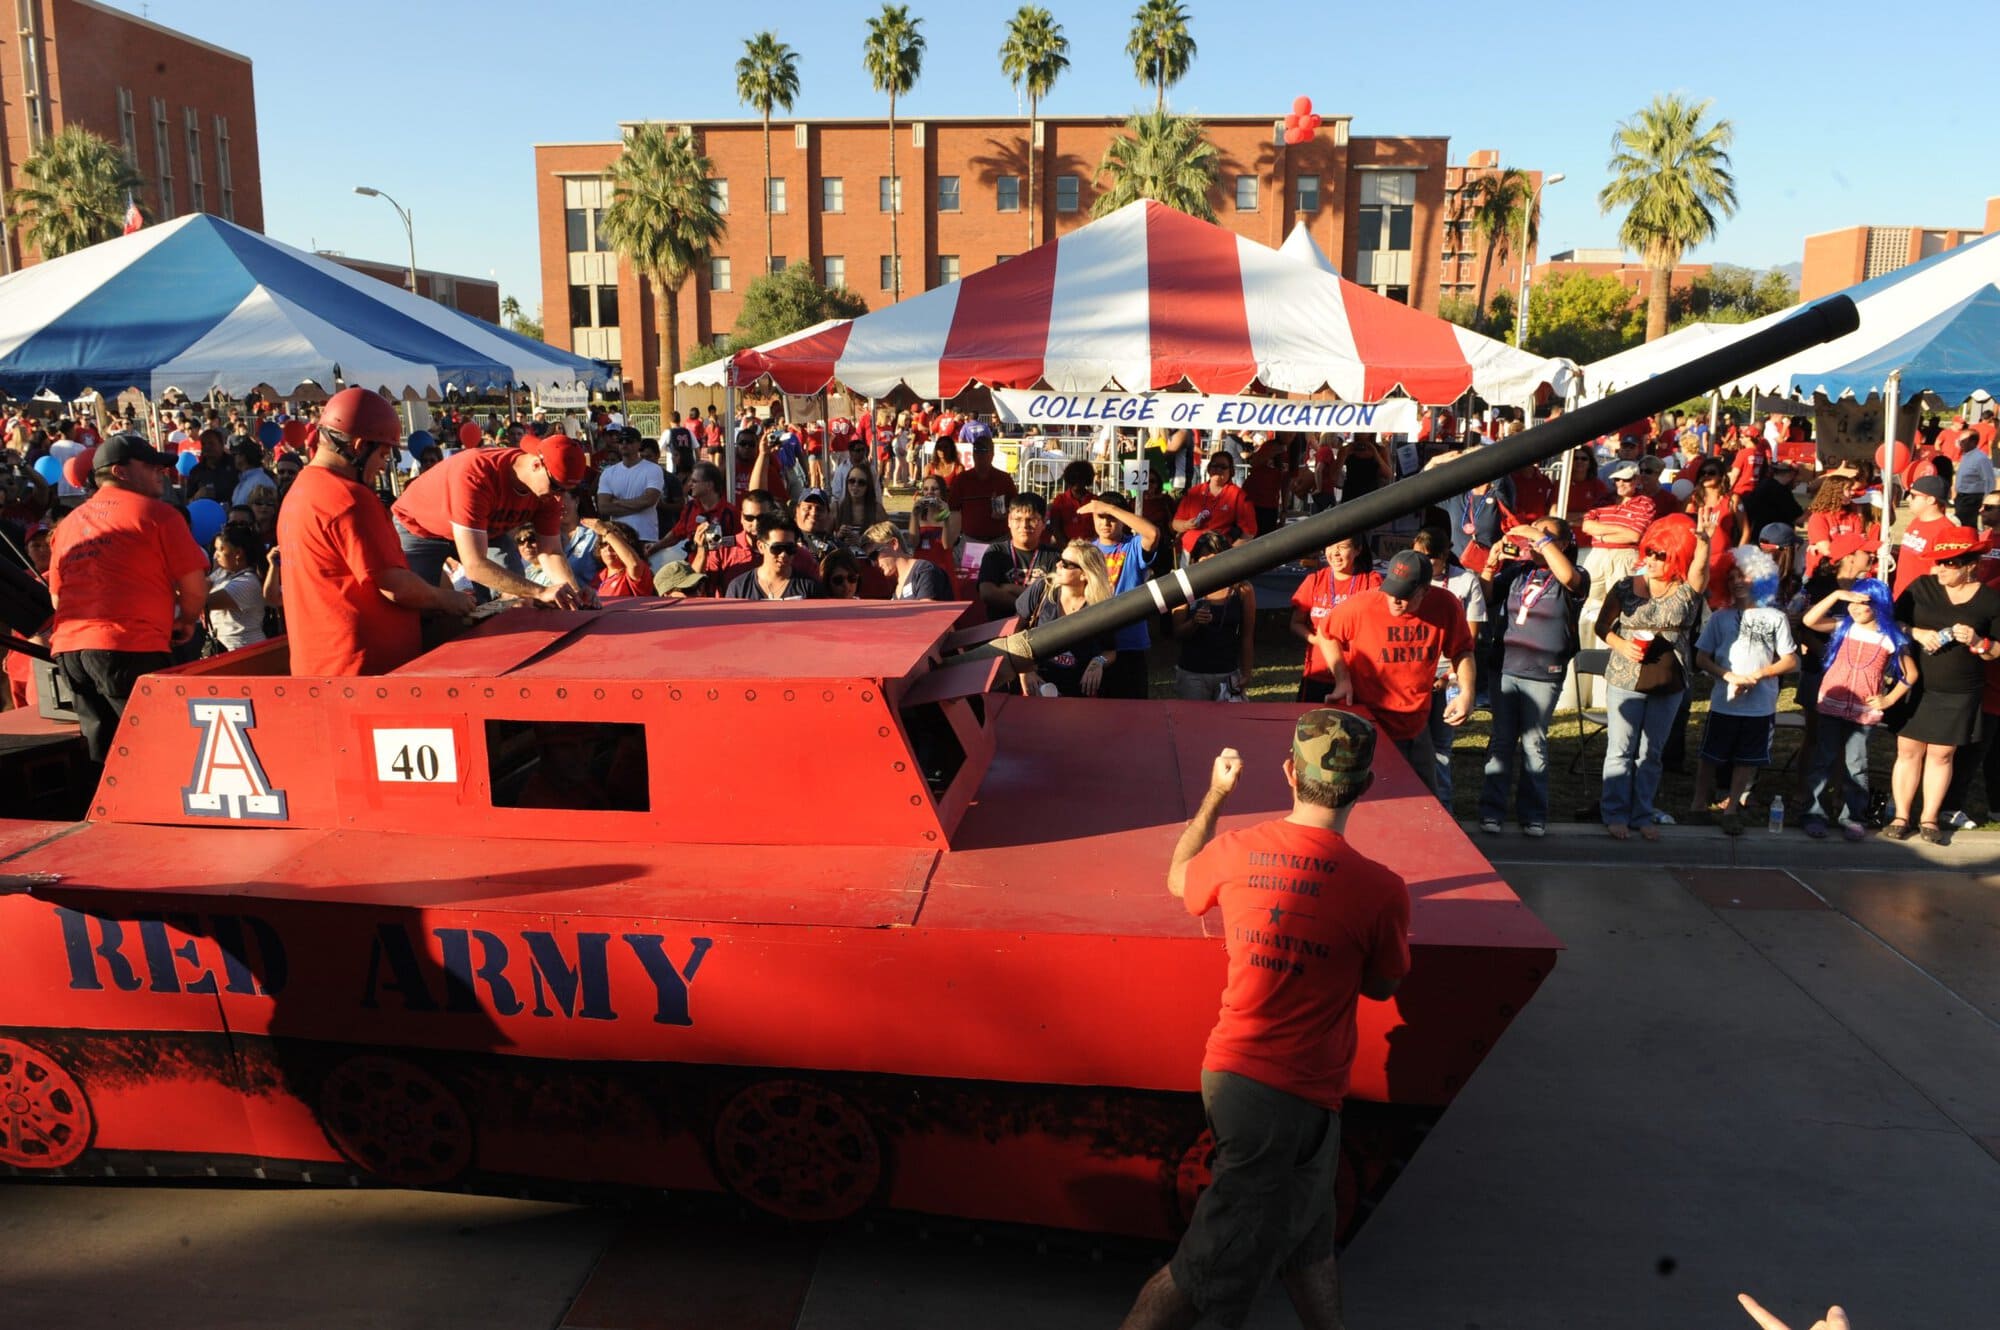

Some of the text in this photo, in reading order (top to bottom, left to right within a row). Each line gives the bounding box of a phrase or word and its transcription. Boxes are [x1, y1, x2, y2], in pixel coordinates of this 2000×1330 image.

[1028, 395, 1378, 427] COLLEGE OF EDUCATION
[1131, 469, 1149, 486] 22
[1387, 625, 1430, 642] RED
[182, 698, 288, 820] A
[391, 743, 439, 782] 40
[1248, 851, 1338, 874] DRINKING
[1247, 874, 1322, 897] BRIGADE
[54, 906, 713, 1027] RED ARMY
